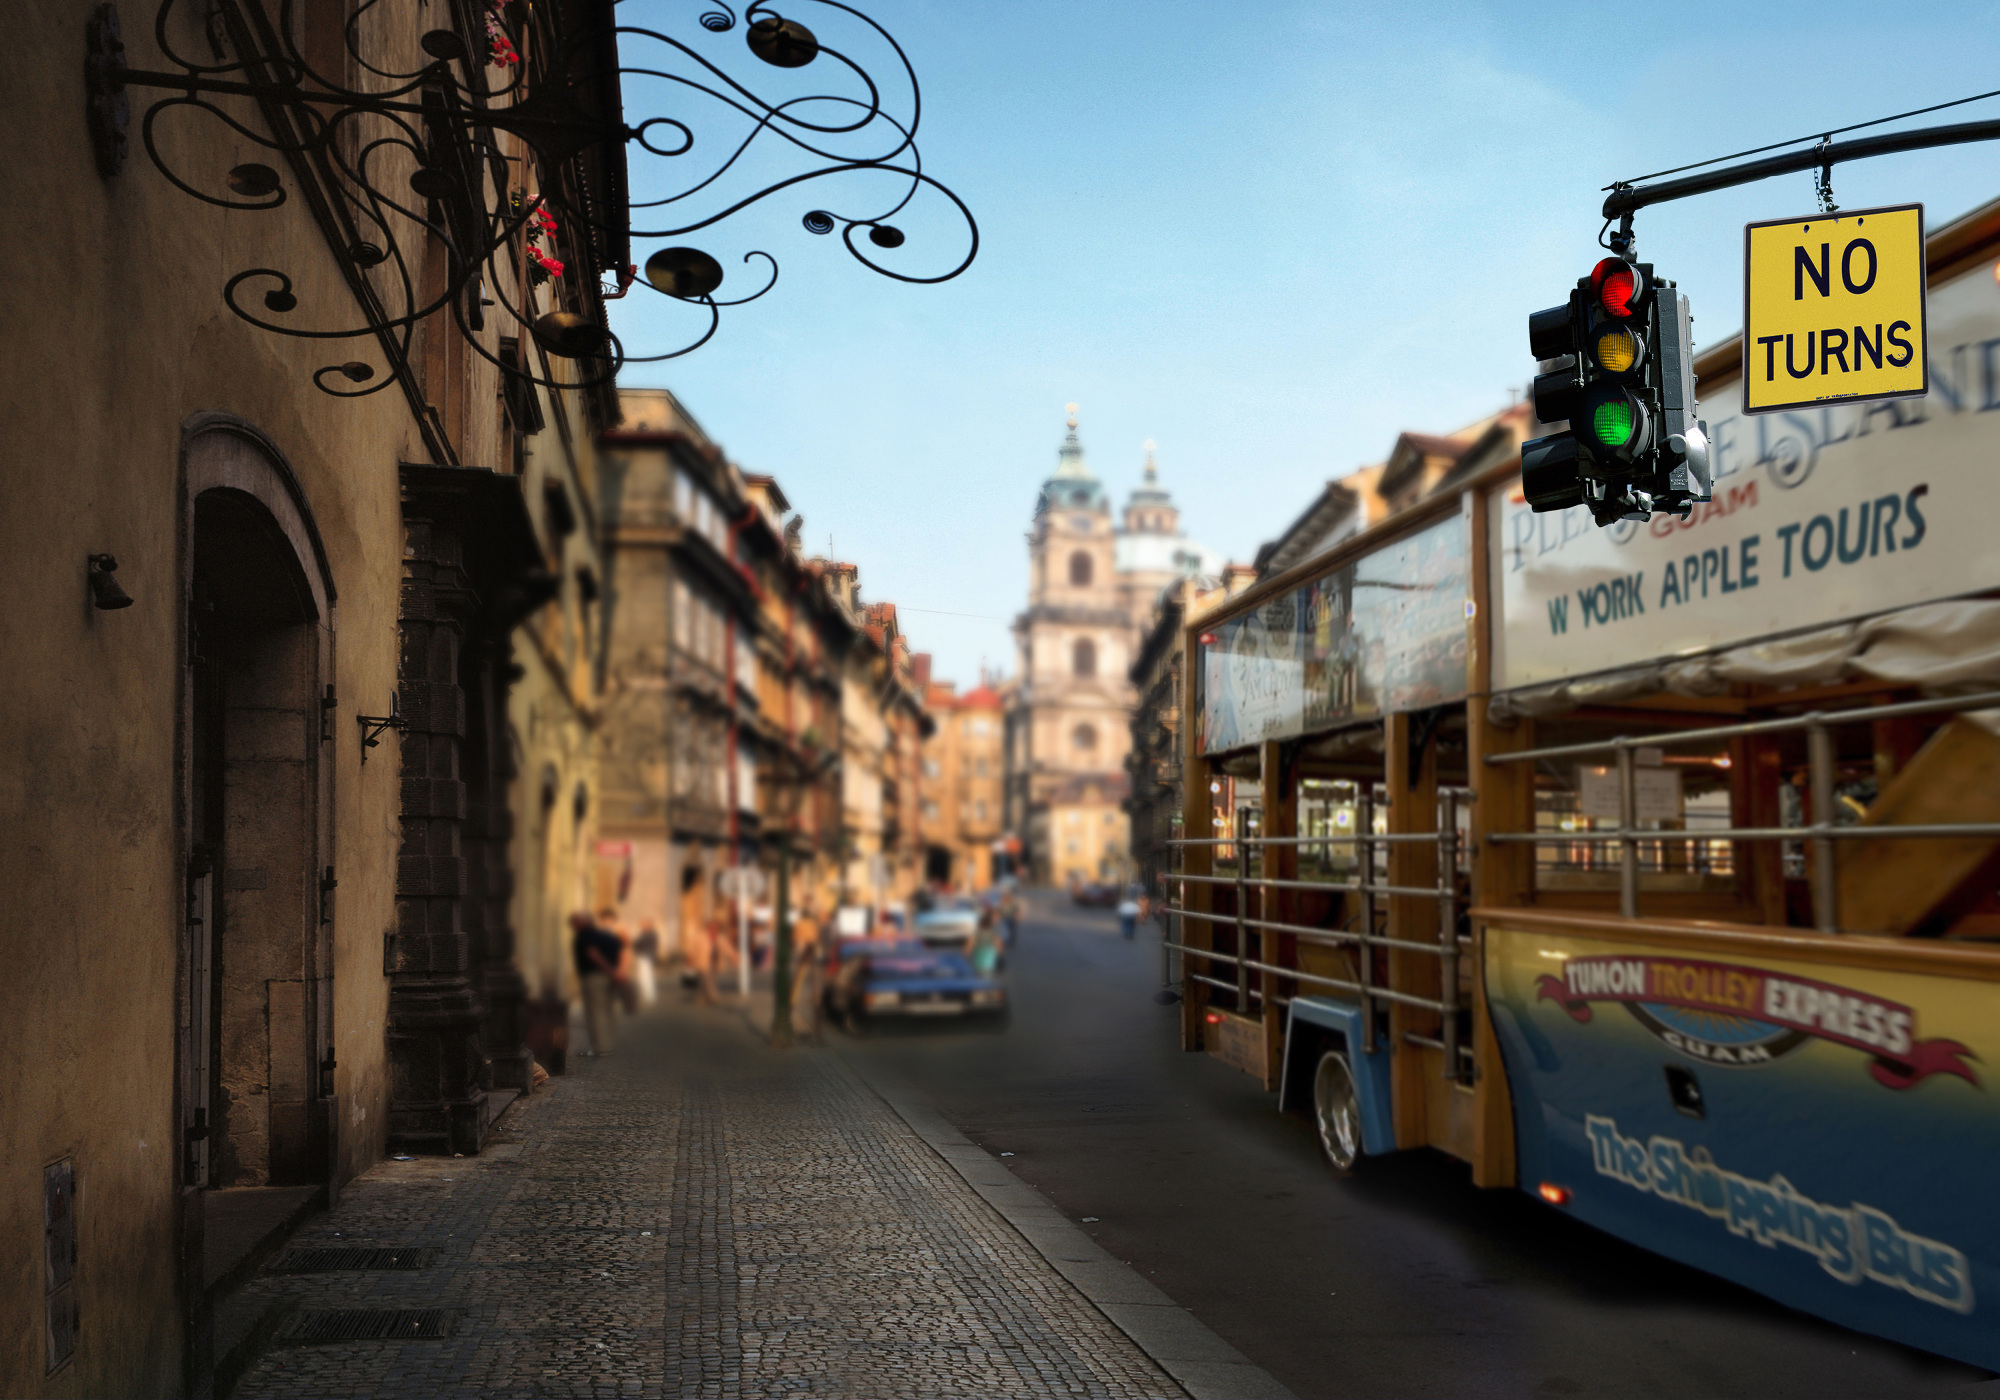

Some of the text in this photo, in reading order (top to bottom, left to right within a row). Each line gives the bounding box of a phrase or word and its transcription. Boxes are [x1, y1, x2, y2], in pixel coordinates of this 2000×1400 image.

[1793, 237, 1878, 301] NO
[1757, 320, 1914, 382] TURNS
[1650, 480, 1758, 538] GUAM
[1577, 571, 1646, 629] YORK
[1659, 534, 1761, 609] APPLE
[1776, 482, 1929, 580] TOURS
[1565, 960, 1913, 1055] TUMON TROLLEY EXPRESS
[1662, 1031, 1773, 1064] GUAM
[1586, 1114, 1650, 1191] The
[1853, 1203, 1974, 1313] Bus
